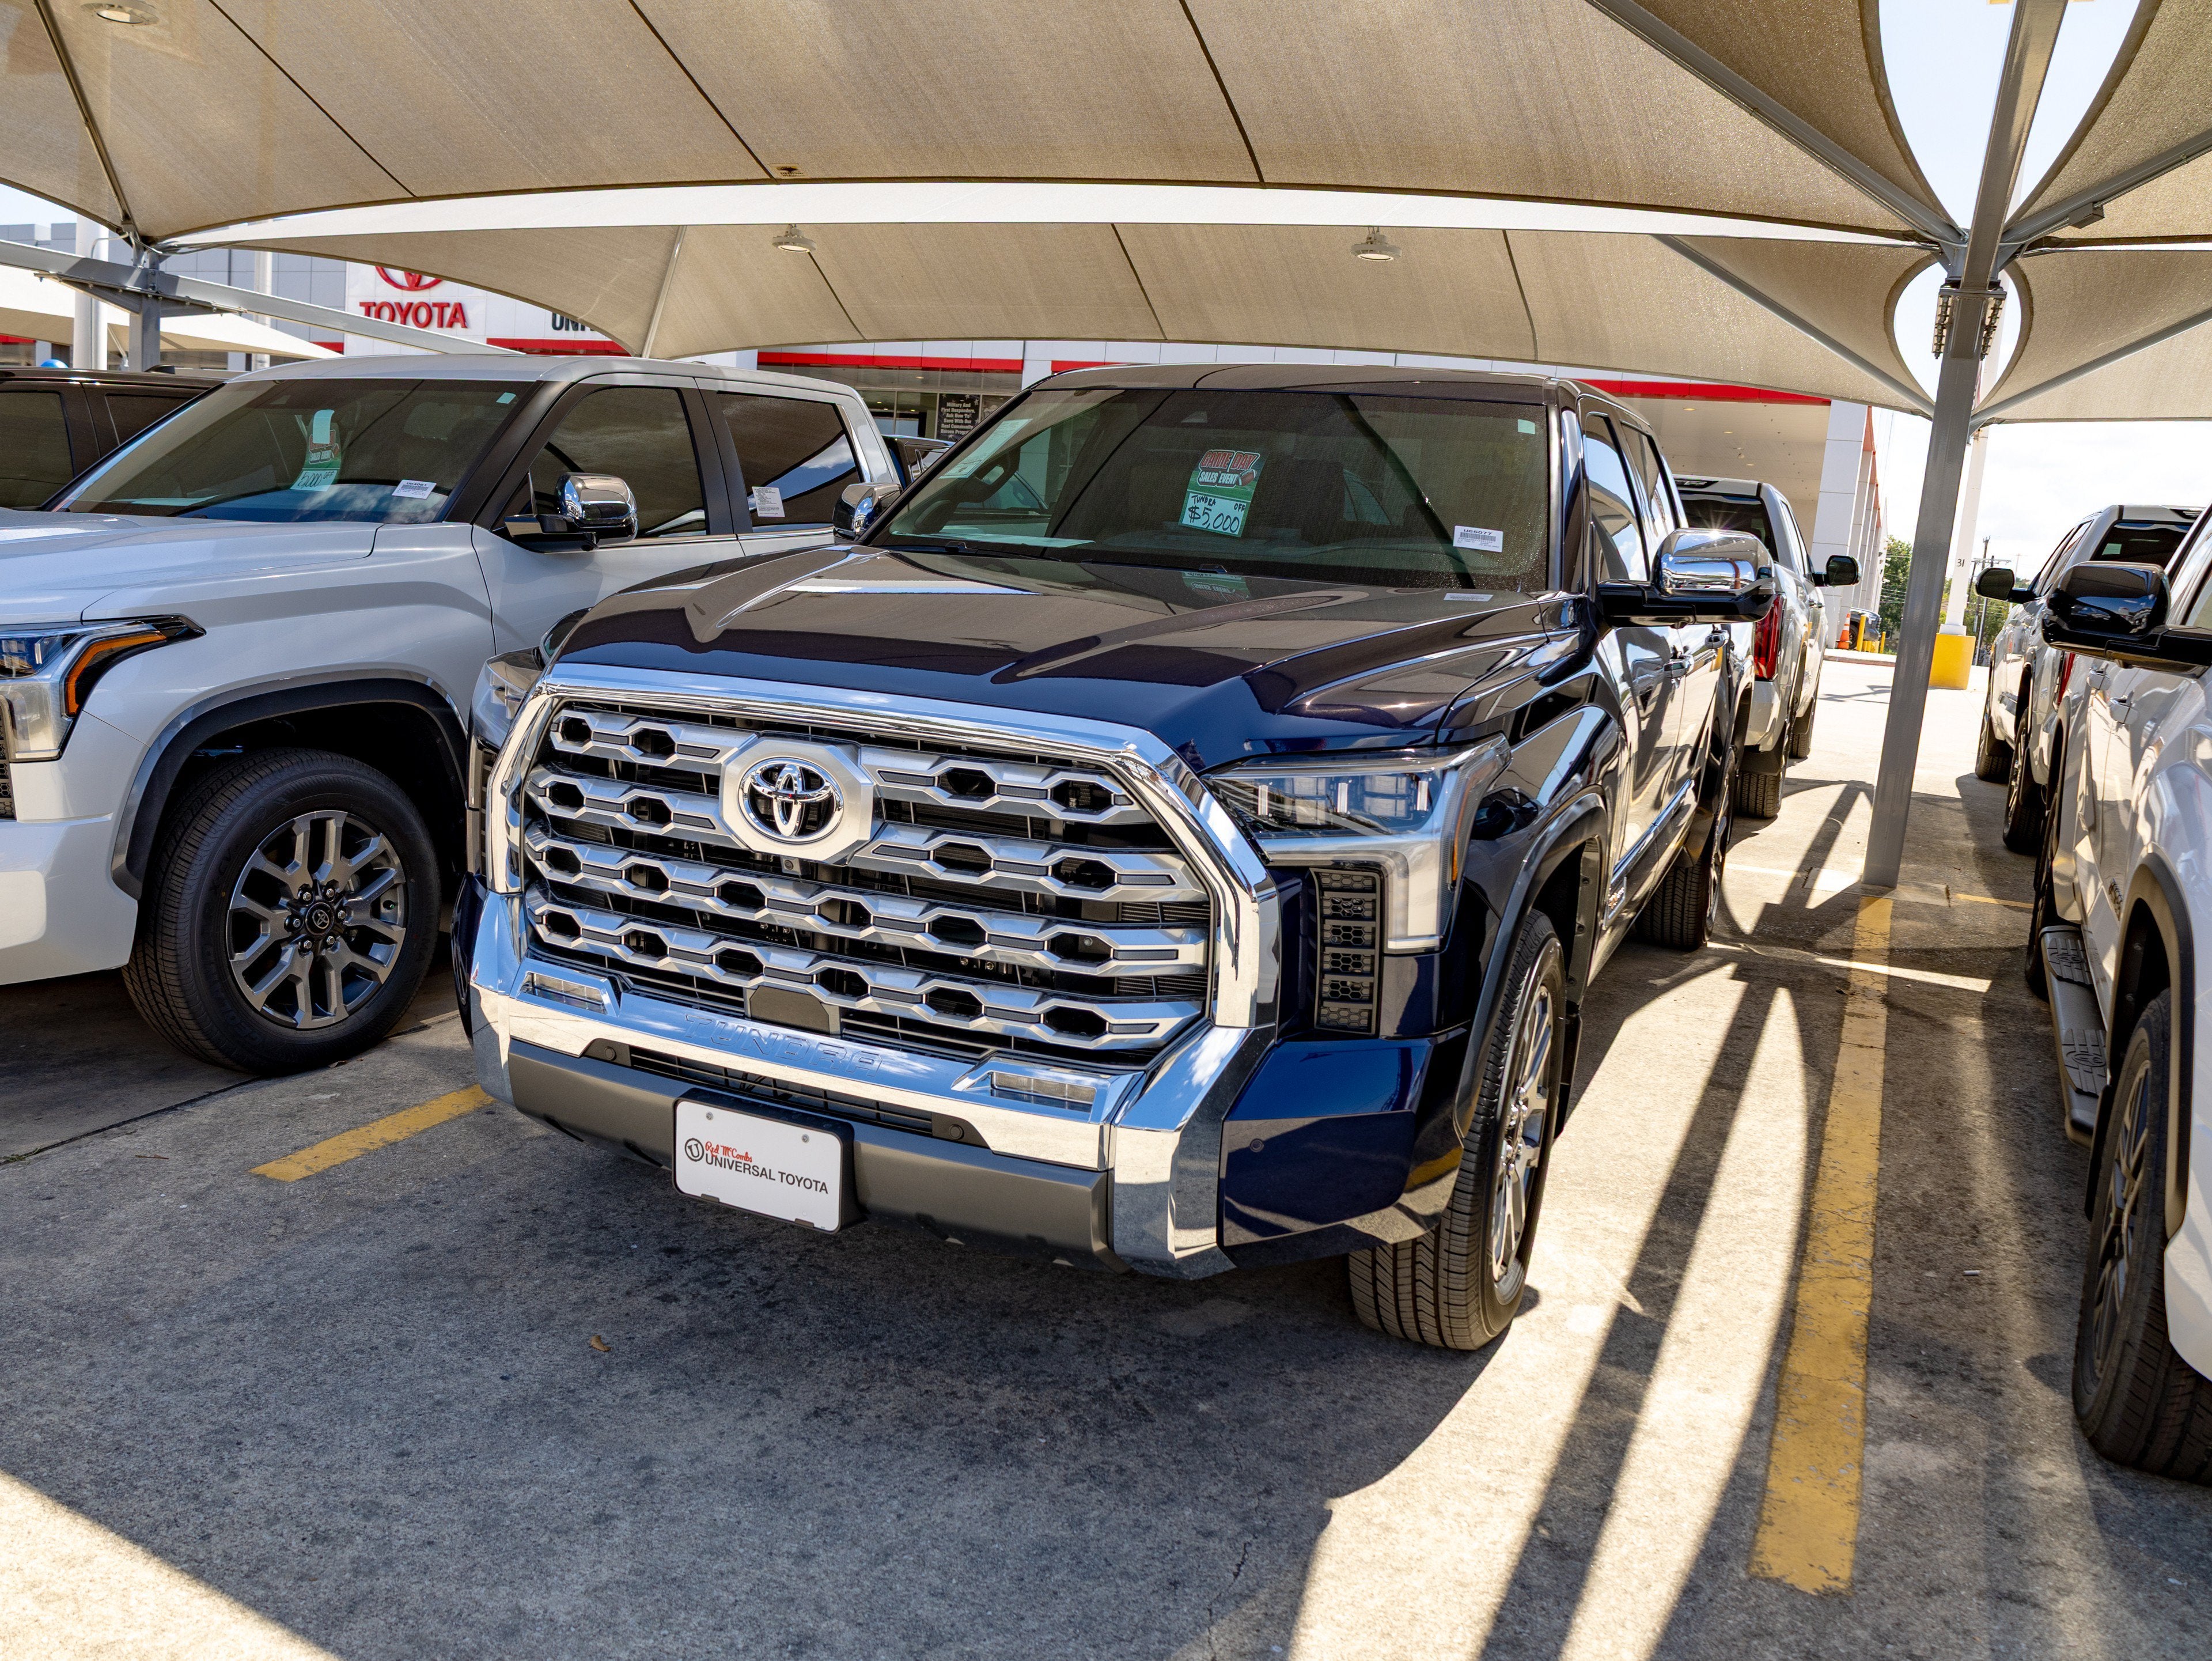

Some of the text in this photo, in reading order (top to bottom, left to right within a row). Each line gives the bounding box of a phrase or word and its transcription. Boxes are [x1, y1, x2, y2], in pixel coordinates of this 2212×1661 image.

[359, 301, 467, 328] TOYOTA
[1200, 452, 1257, 470] GAME DAY
[1199, 471, 1239, 485] SALES EVENT
[1191, 495, 1216, 506] TUNDRA
[1188, 505, 1240, 533] $5,000
[1957, 558, 1965, 567] 31
[685, 1013, 883, 1077] TUNDRA
[705, 1141, 752, 1163] Red McCombs
[706, 1153, 828, 1194] UNIVERSAL TOYOTA
